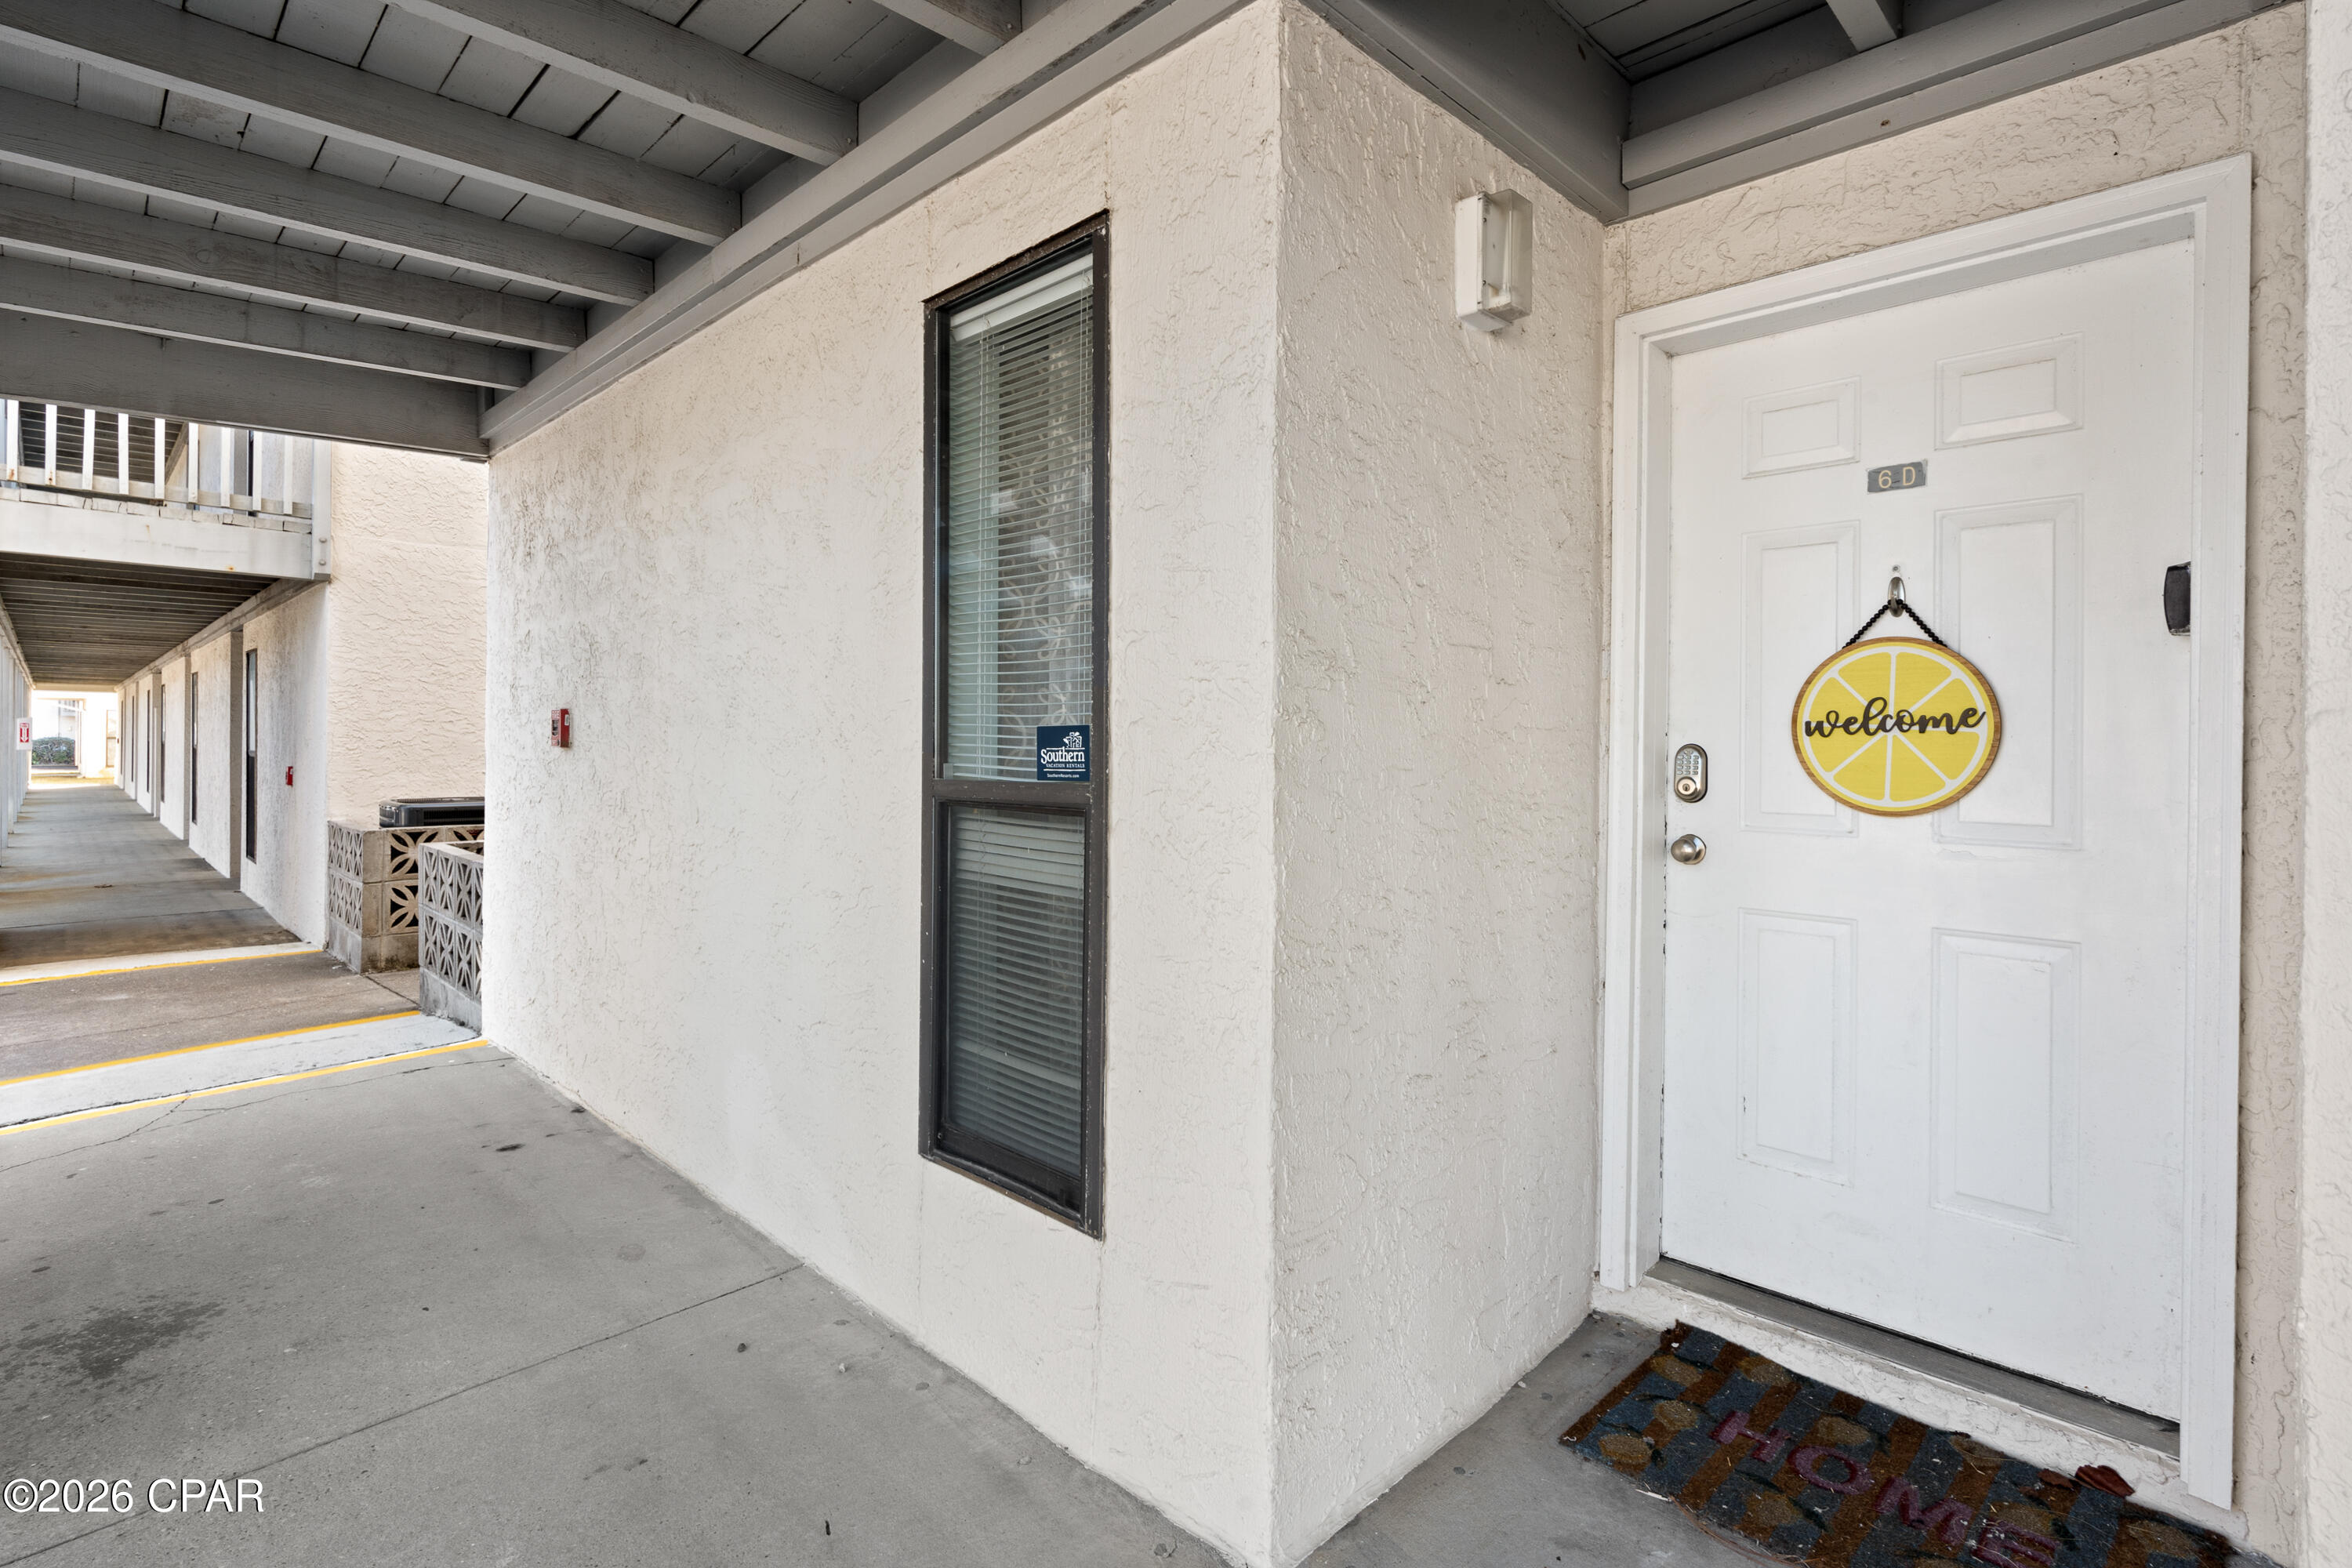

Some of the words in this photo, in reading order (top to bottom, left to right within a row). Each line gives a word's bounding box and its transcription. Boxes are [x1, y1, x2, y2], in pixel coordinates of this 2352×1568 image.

[1878, 470, 1892, 488] 6
[1903, 466, 1915, 485] D
[1804, 696, 1986, 739] welcome
[1040, 746, 1085, 764] Southern
[1708, 1410, 2063, 1568] HOME
